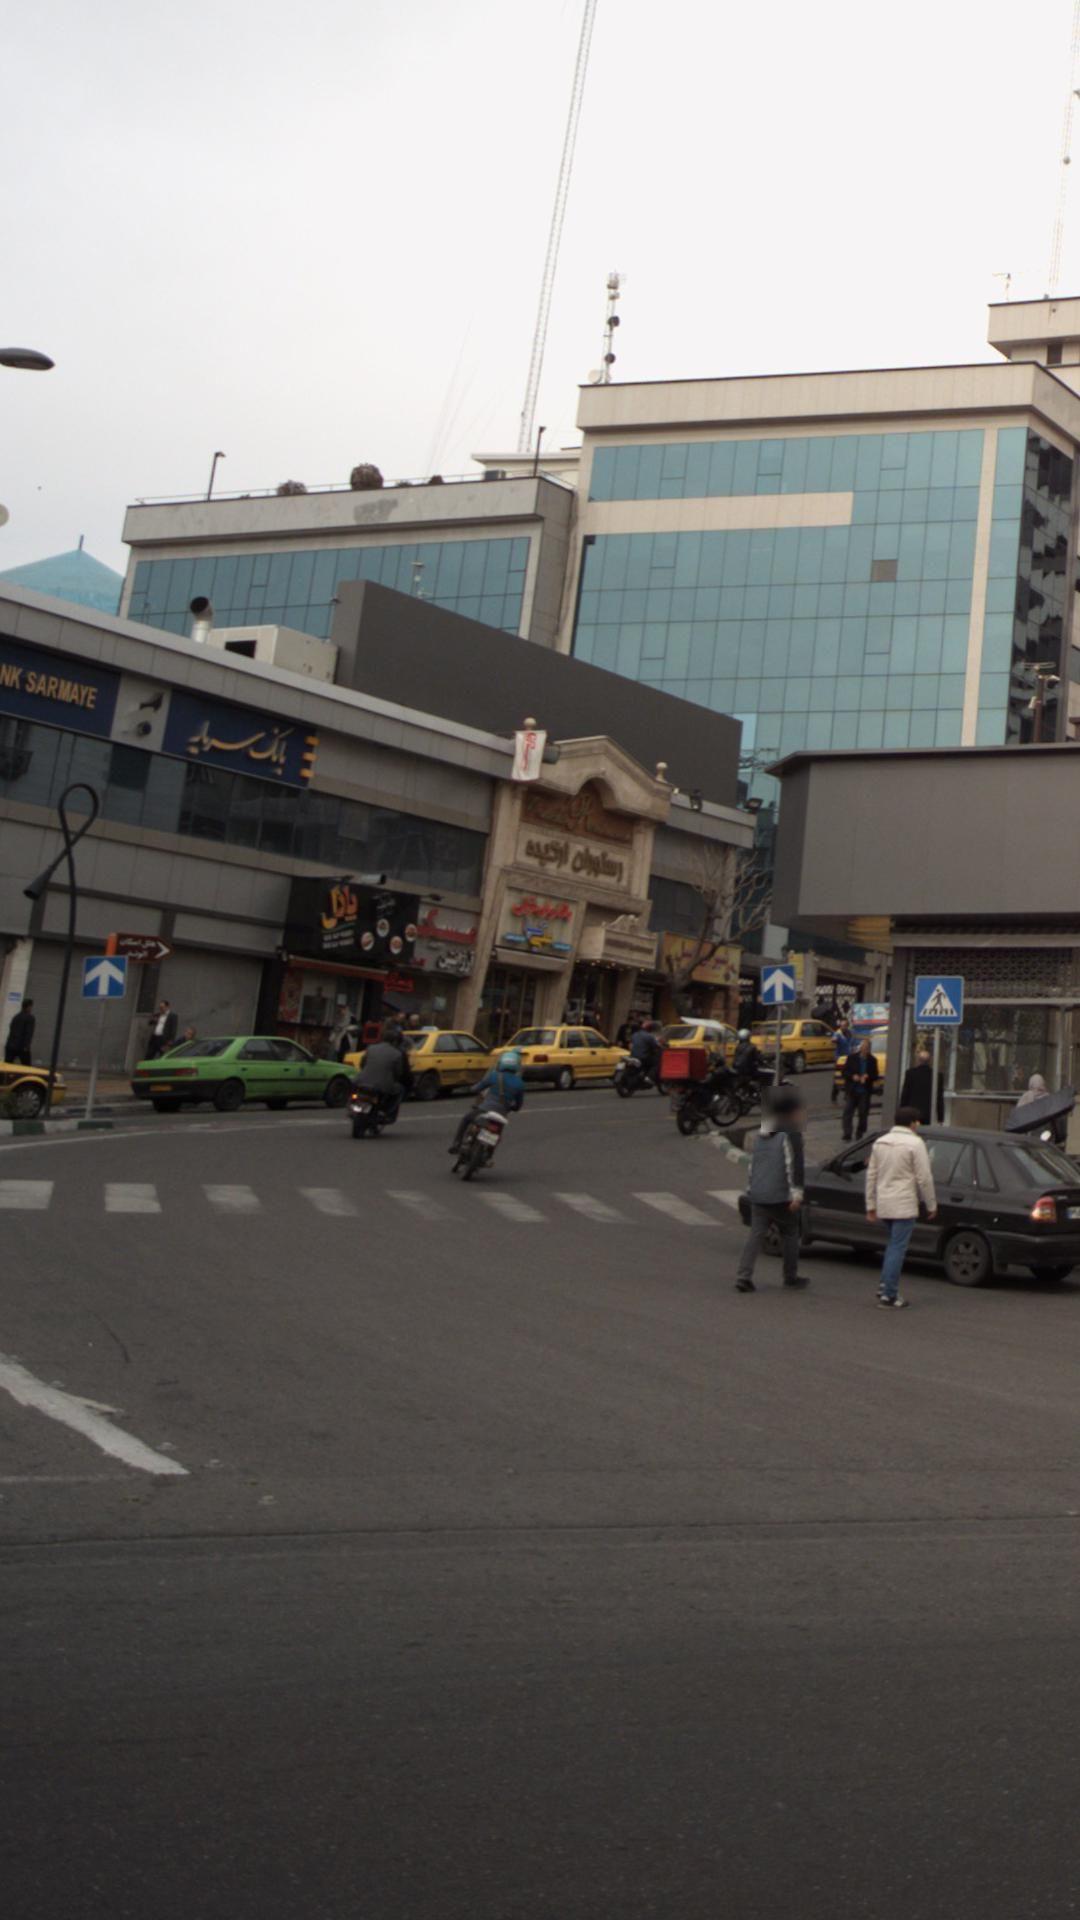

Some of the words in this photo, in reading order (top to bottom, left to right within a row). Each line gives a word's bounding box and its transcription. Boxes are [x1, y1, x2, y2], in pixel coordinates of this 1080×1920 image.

[25, 671, 98, 709] SARMAYE
[185, 720, 267, 756] سرمایه
[246, 727, 296, 776] بانک
[525, 839, 569, 869] ارکیده
[571, 847, 624, 883] رستوران
